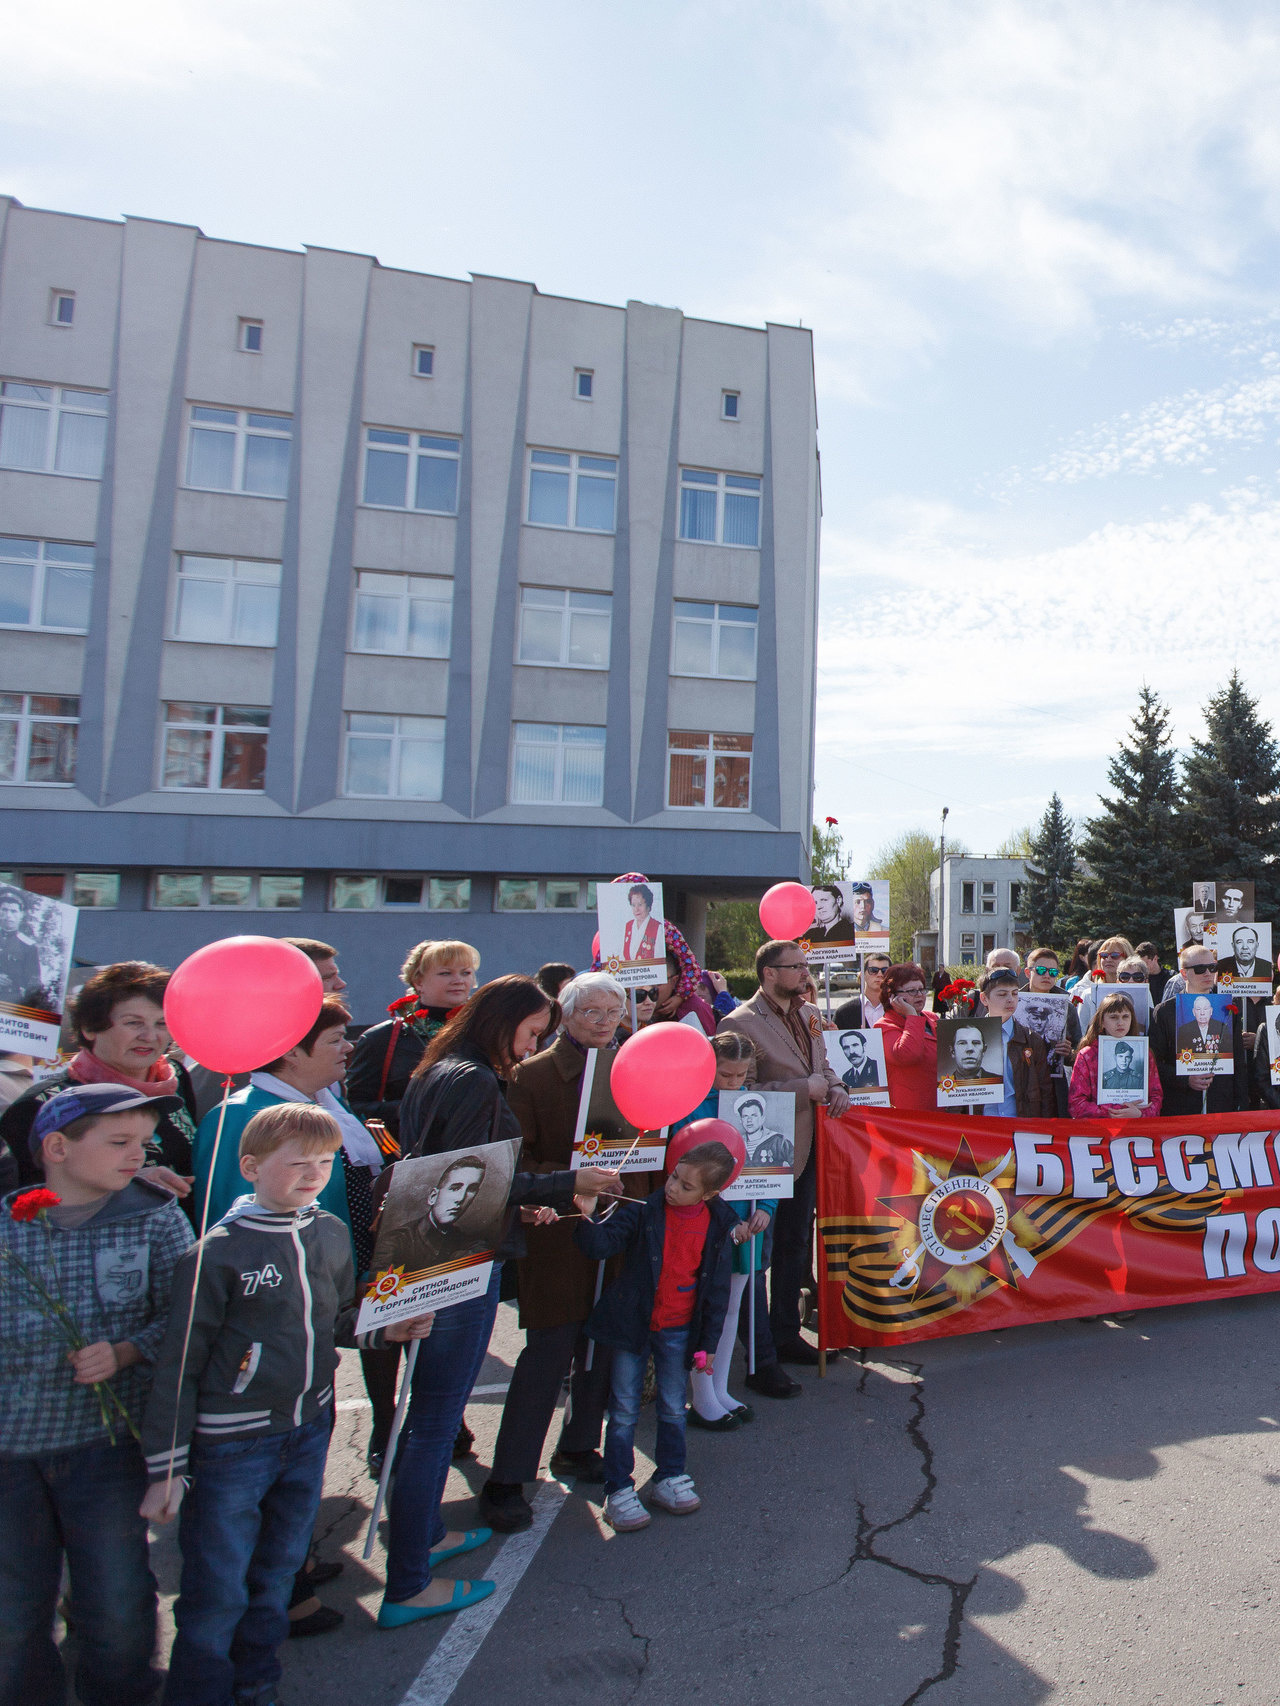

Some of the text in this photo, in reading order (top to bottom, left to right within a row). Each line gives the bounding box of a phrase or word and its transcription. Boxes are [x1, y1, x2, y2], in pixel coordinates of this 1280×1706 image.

[579, 1159, 609, 1168] ВИКТОР
[921, 1178, 1005, 1257] ОТЕЧЕСТВЕННАЯ ВОЙНА
[240, 1263, 283, 1296] 74
[374, 1294, 418, 1314] ГЕОРГИЙ
[418, 1276, 480, 1299] ЛЕОНИДОВИЧ
[412, 1278, 449, 1295] СИТНОВ
